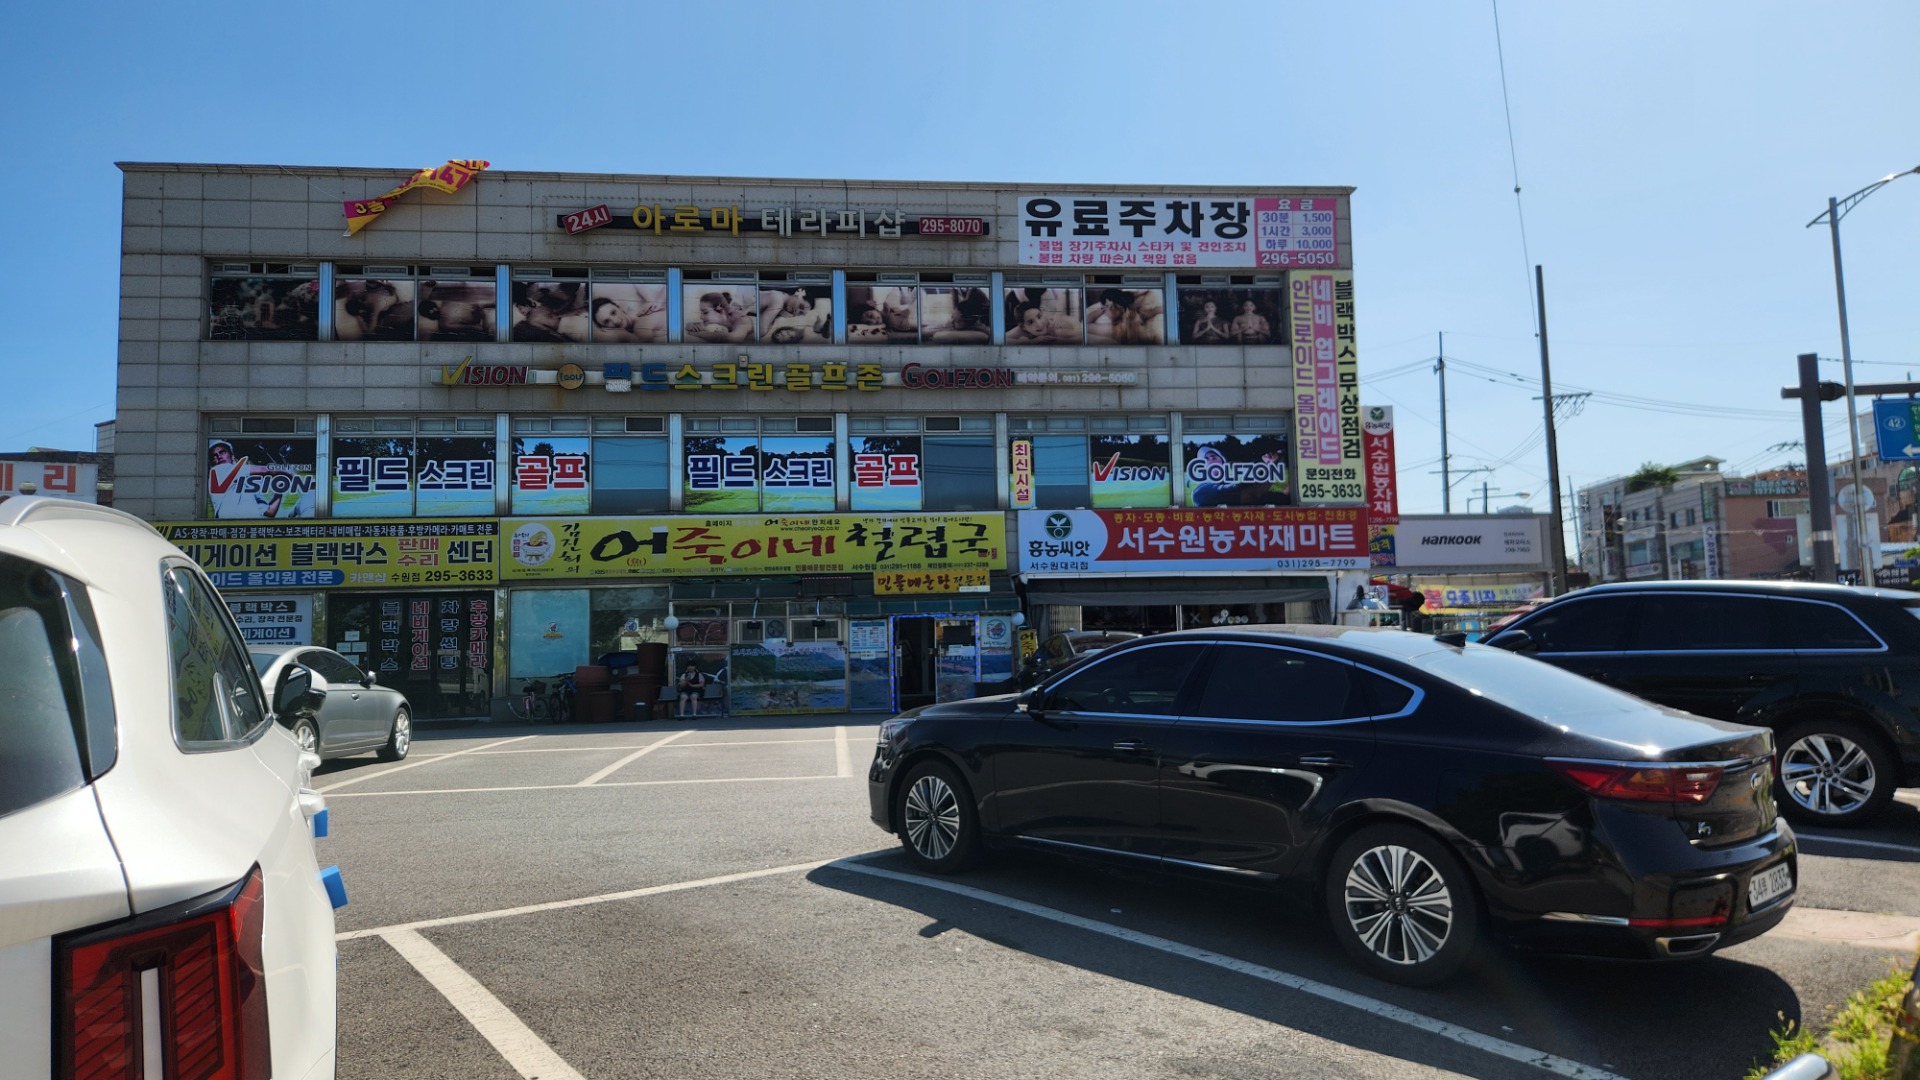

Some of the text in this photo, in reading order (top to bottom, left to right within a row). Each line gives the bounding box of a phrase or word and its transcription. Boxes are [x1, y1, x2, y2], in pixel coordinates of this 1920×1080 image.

[567, 203, 980, 239] 24시 아로마 테라피샵 295-8070
[1025, 198, 1250, 239] 유료주차장
[1263, 212, 1289, 223] 30분
[1261, 226, 1290, 237] 1시간
[1039, 241, 1246, 252] 불법 장기주차시 스티커 및 견인조치
[1266, 239, 1288, 250] 하루
[1039, 253, 1197, 265] 불법 차량 파손시 책임 없음
[1261, 253, 1334, 265] 296-5050
[442, 356, 528, 385] VISION
[900, 362, 1013, 389] GOLFZON
[1292, 279, 1318, 460] 안드로이드 올인원
[1312, 279, 1341, 461] 네비 업그레이드
[210, 456, 313, 494] VISION
[337, 456, 587, 493] 필드 스크린 골프
[687, 454, 919, 490] 필드 스크린 골프
[1014, 443, 1031, 501] 최신시설
[1093, 451, 1168, 482] VISION
[1187, 458, 1285, 483] GOLFZON
[1305, 468, 1356, 481] 문의전화
[1370, 436, 1393, 514] 서수원농자재
[1301, 483, 1362, 499] 295-3633
[398, 538, 440, 551] 판매
[1029, 541, 1090, 557] 흥농씨앗
[1118, 524, 1356, 553] 서수원농자재마트
[291, 541, 388, 566] 블랙박스
[397, 553, 440, 567] 수리
[447, 540, 493, 564] 센터
[1278, 559, 1356, 568] 031)295-7799
[391, 573, 420, 582] 수원점
[425, 570, 493, 582] 295-3633
[1030, 561, 1088, 570] 서수원대리점
[248, 572, 296, 586] 올인원
[302, 571, 333, 585] 전문
[878, 574, 986, 591] 민물매운탕 전문점
[231, 603, 288, 613] 블랙박스
[381, 601, 399, 671] 블랙박스
[411, 601, 429, 670] 네비게이션
[470, 600, 488, 669] 후방카메라
